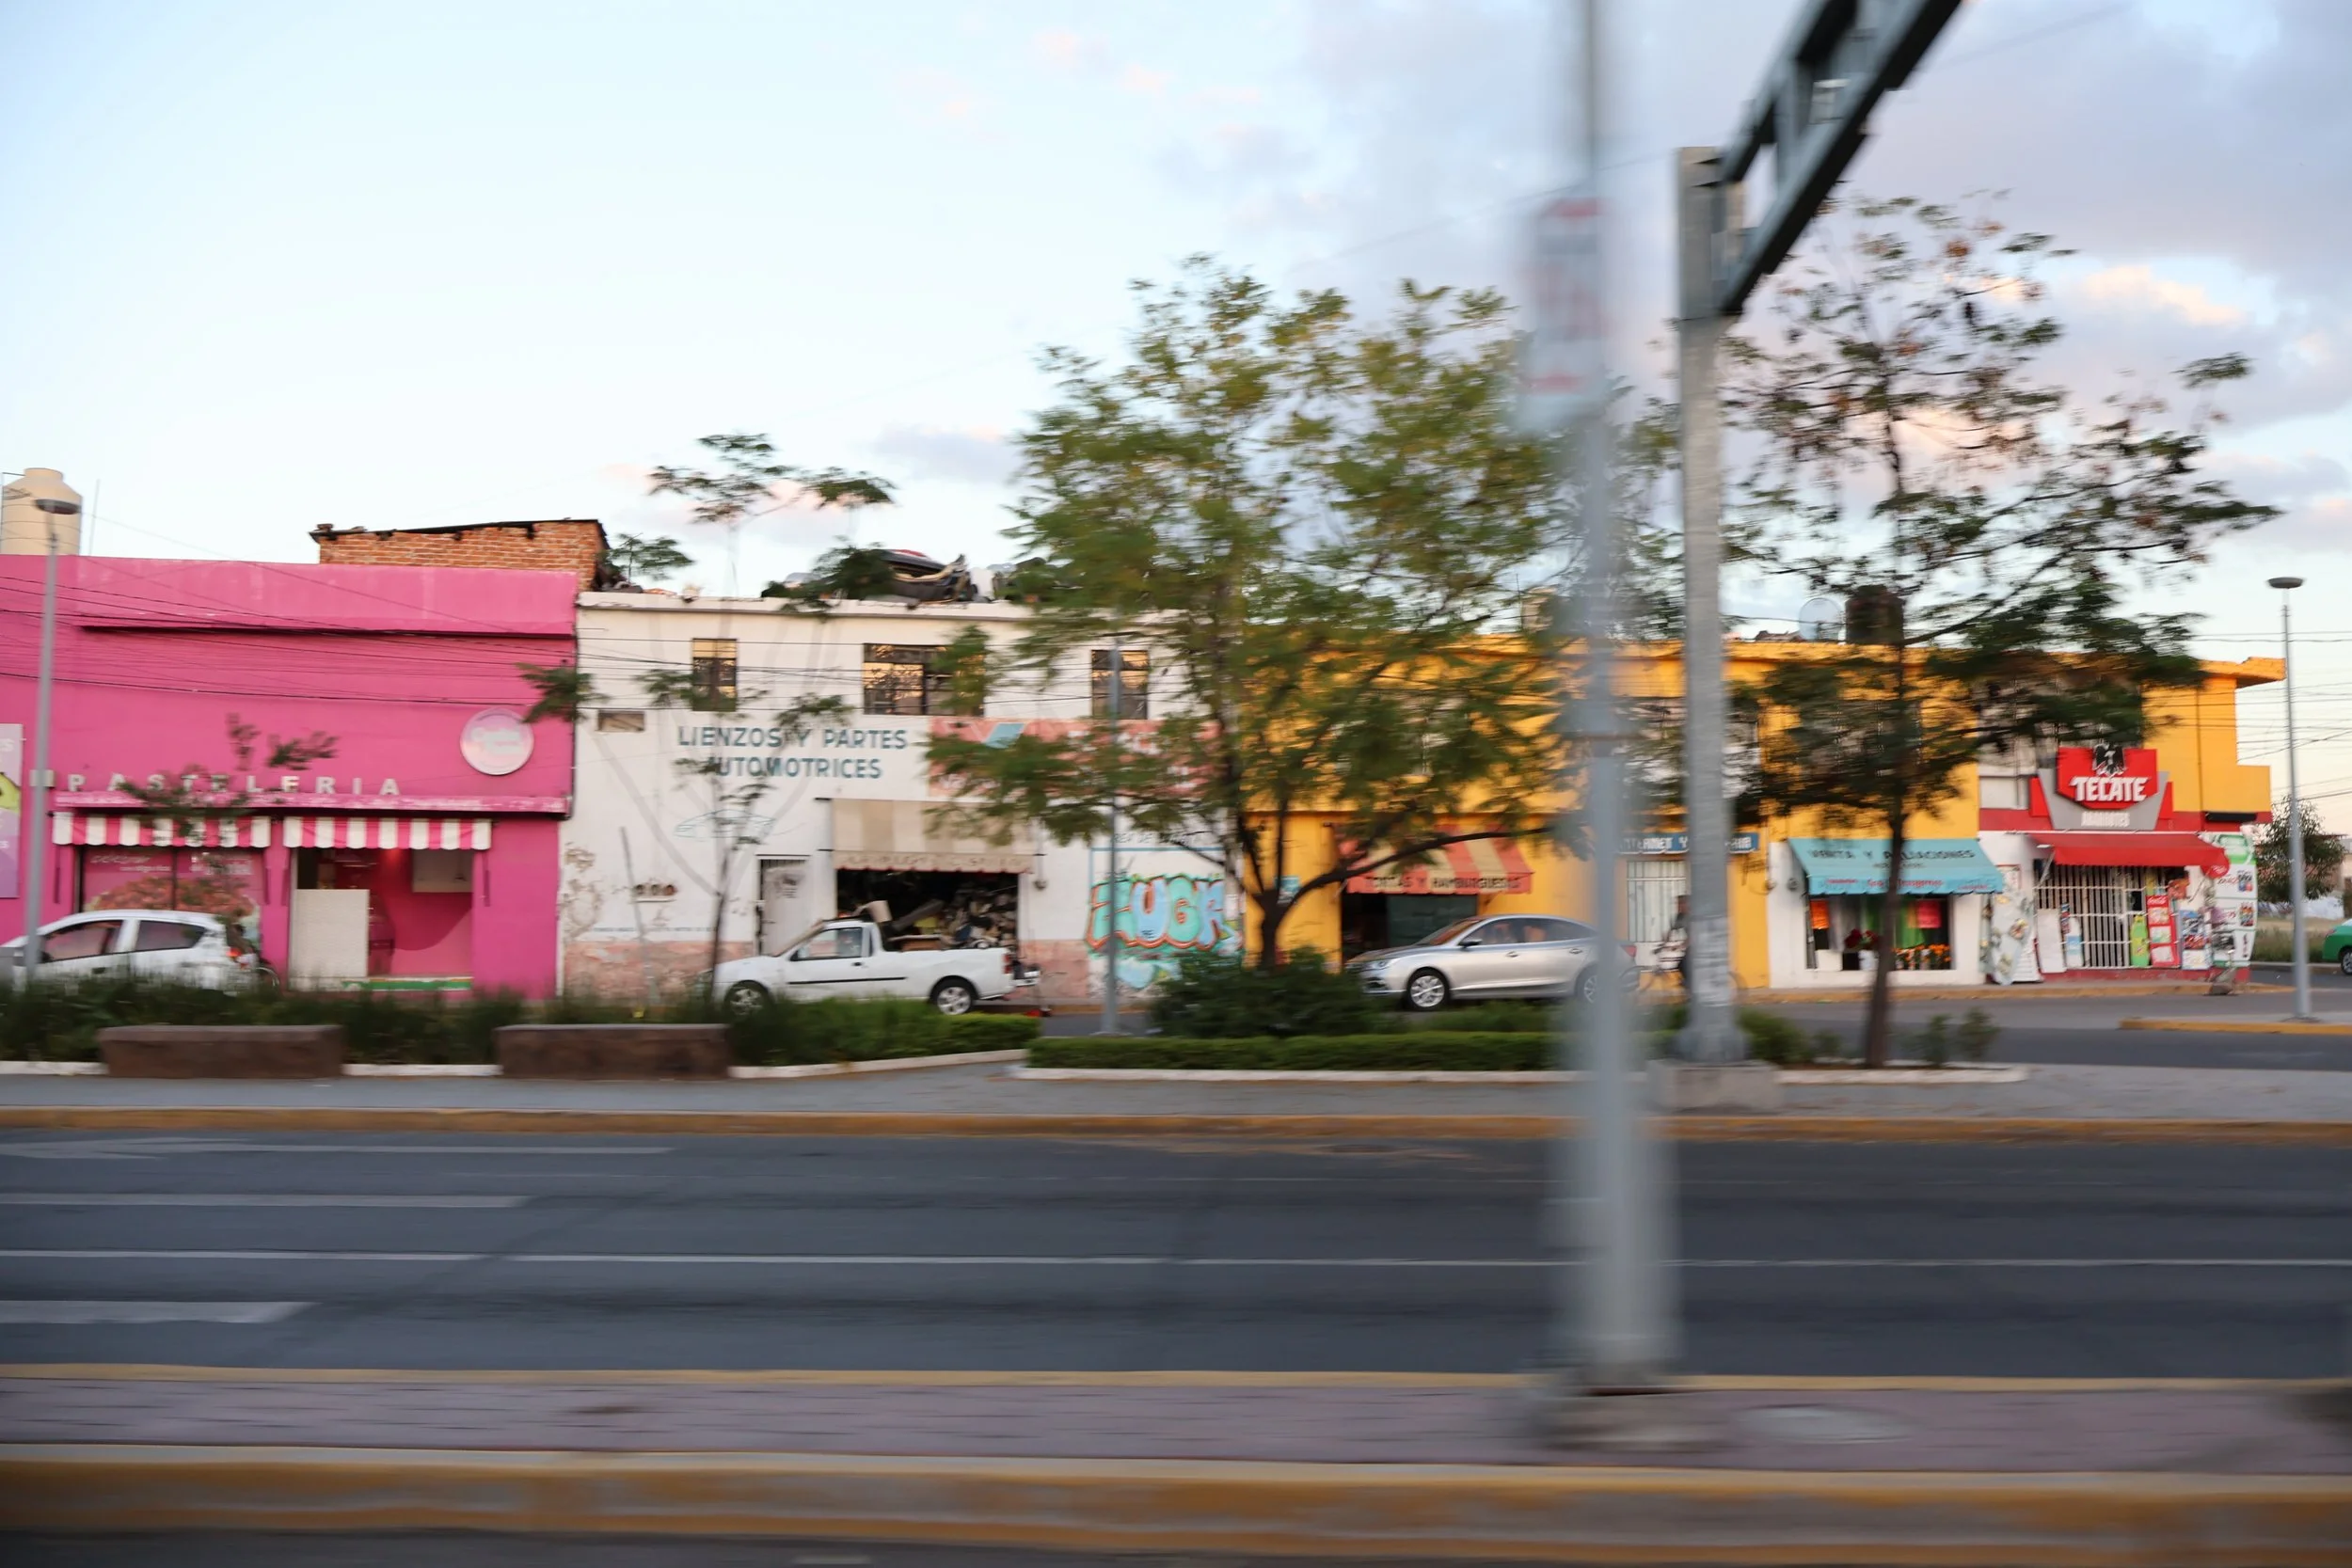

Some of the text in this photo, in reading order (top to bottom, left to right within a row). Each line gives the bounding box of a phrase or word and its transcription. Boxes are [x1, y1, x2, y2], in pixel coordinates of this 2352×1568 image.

[678, 727, 908, 749] LIENZOS Y PARTES
[68, 771, 400, 796] PASTELERIA
[2070, 776, 2149, 801] TECATE
